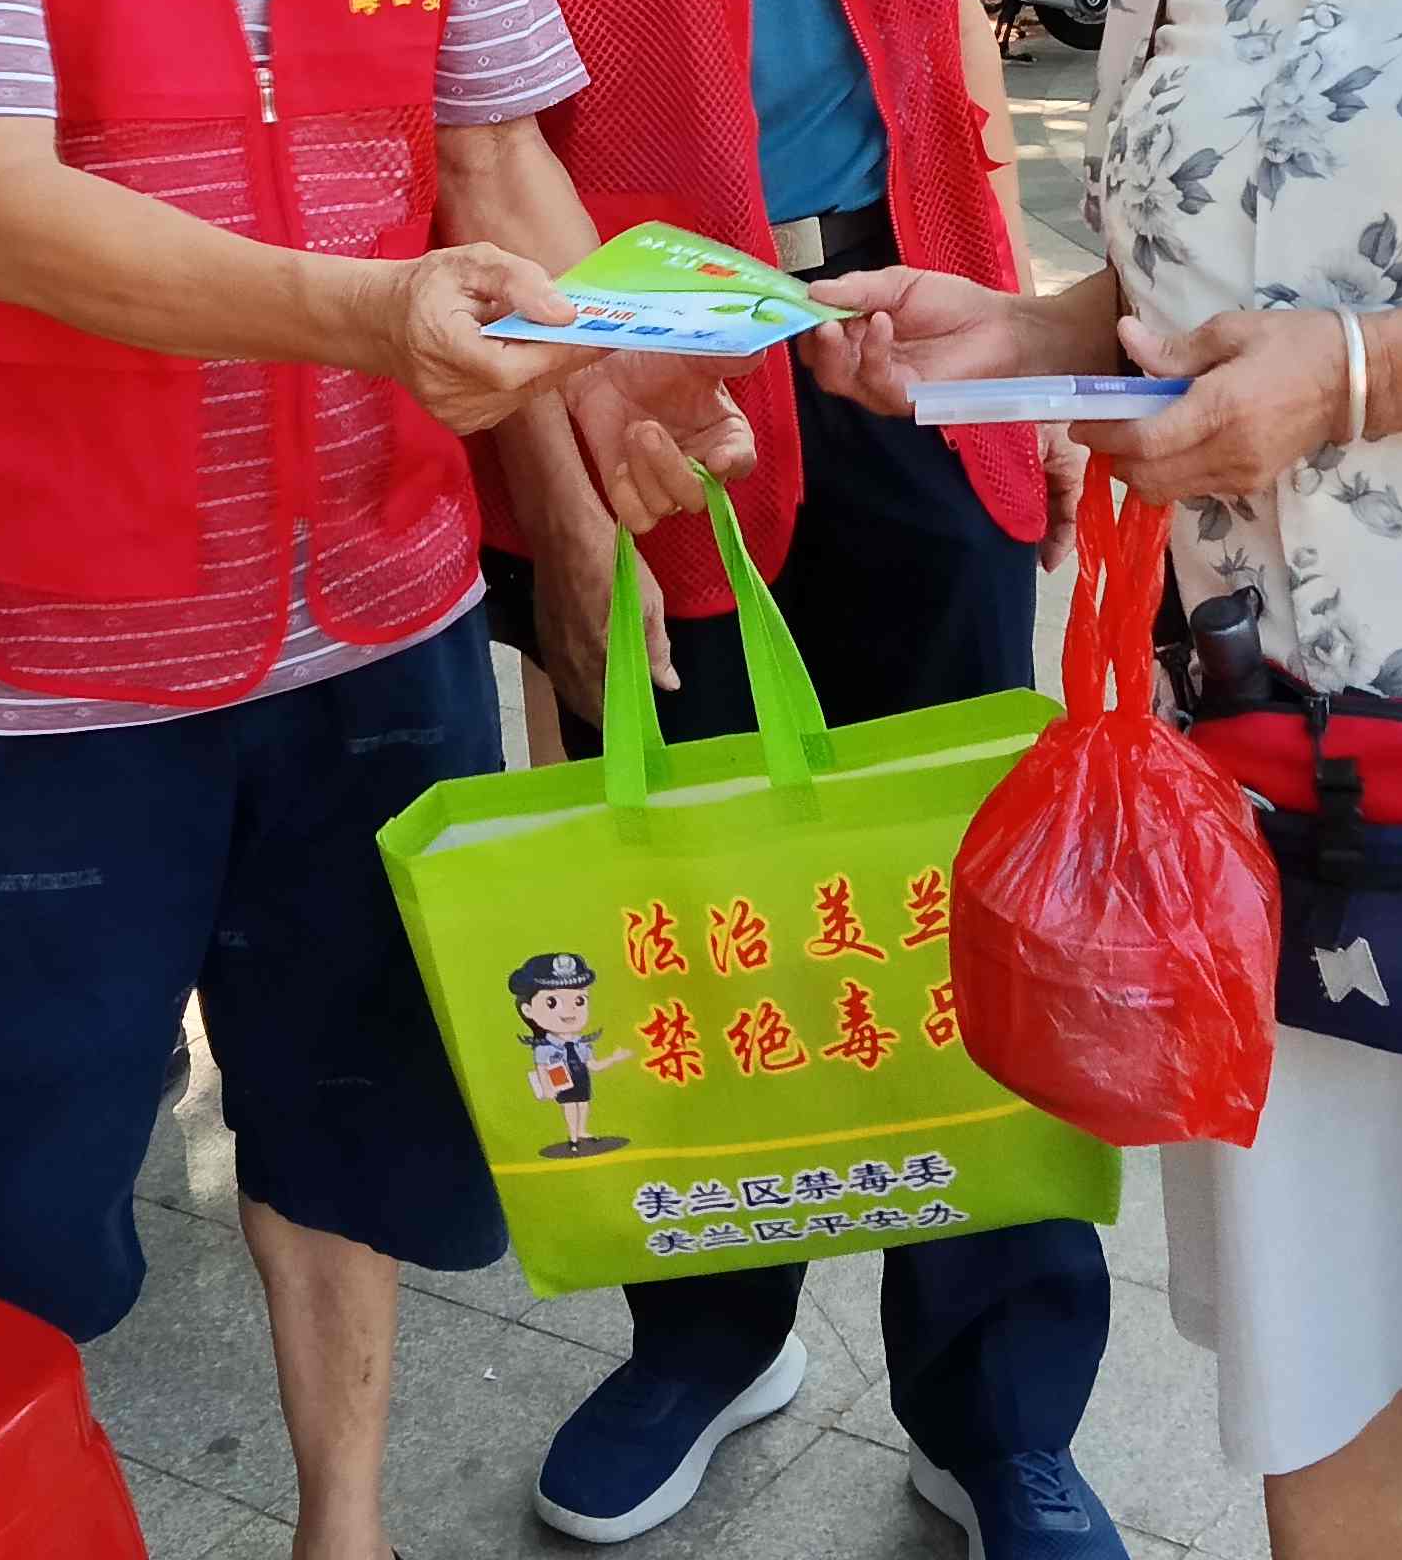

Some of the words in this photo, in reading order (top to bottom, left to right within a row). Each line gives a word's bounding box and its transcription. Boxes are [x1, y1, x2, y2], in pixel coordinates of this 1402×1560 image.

[623, 869, 950, 975] 法治美兰
[636, 1154, 953, 1220] 美兰区禁毒委
[650, 1203, 967, 1254] 美兰区平安办
